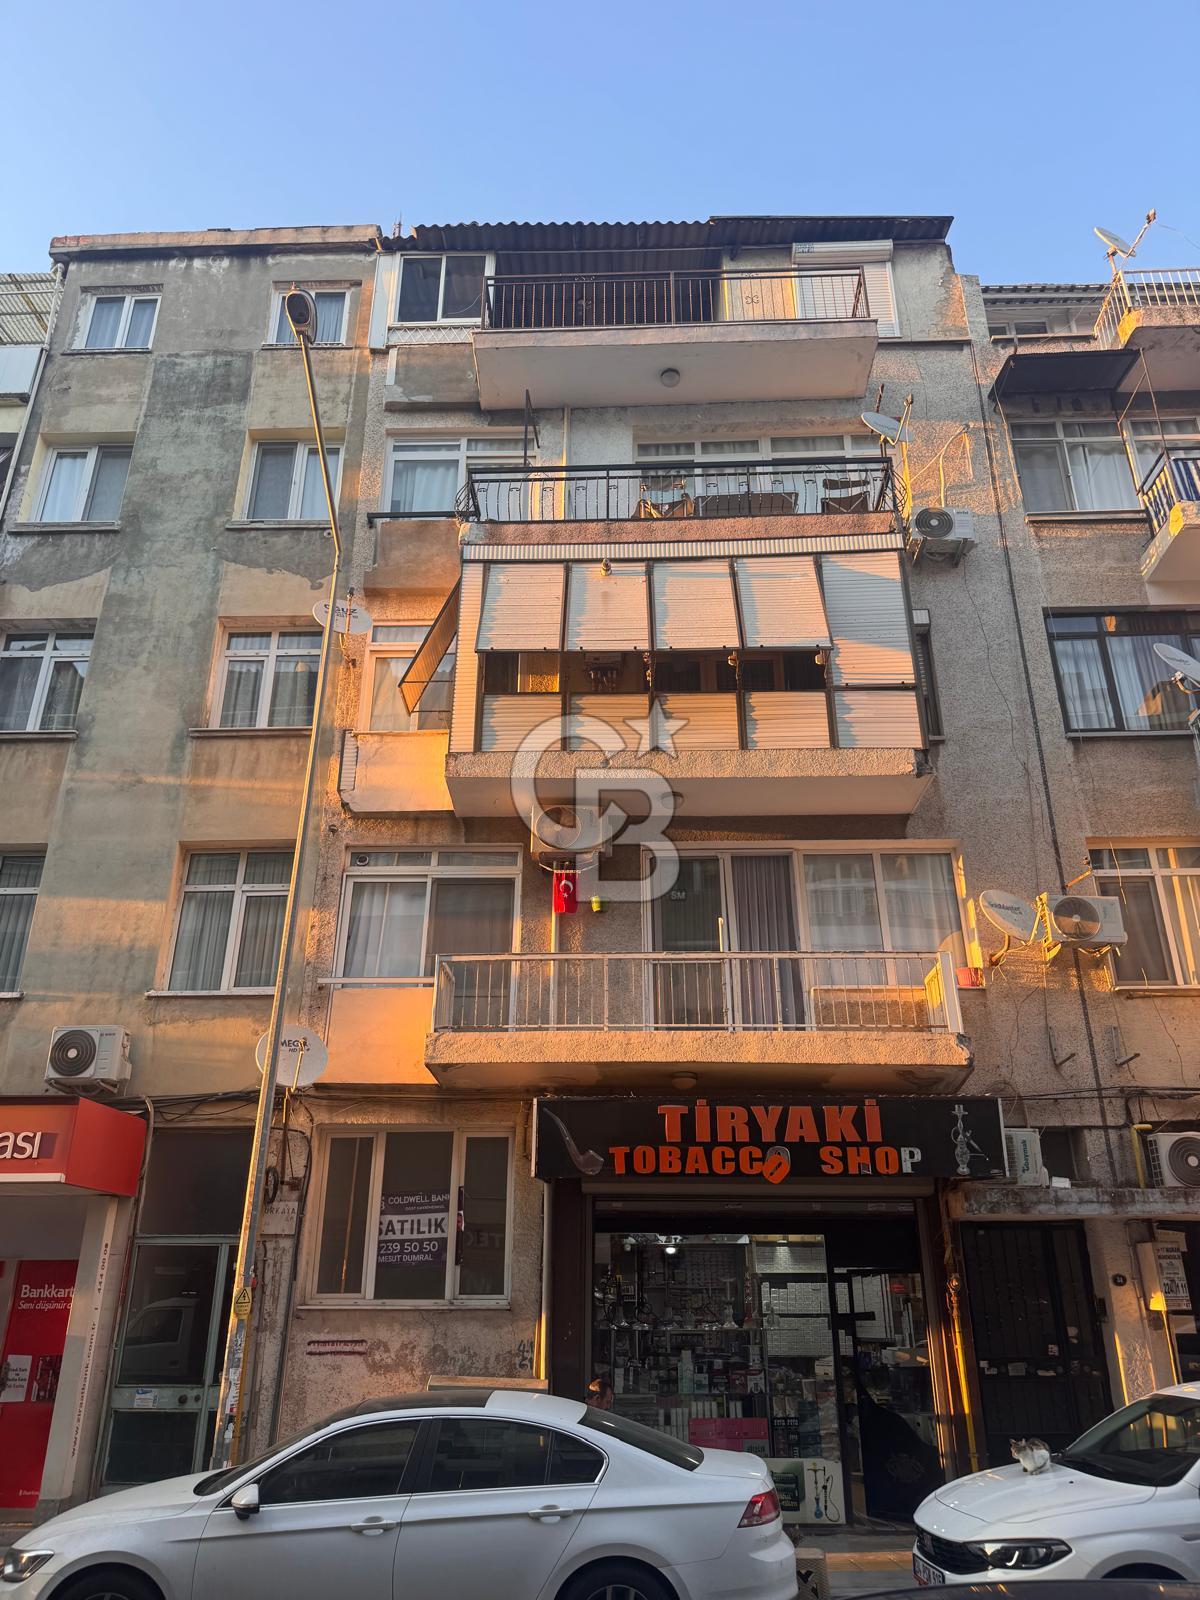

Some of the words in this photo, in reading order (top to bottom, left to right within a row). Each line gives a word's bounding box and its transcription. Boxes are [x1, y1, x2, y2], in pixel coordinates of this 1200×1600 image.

[657, 1099, 883, 1143] TİRYAKİ
[820, 1146, 922, 1176] SHOP
[388, 1195, 430, 1205] COLDWELL
[431, 1193, 450, 1203] BAN
[379, 1242, 401, 1254] 239
[404, 1242, 420, 1253] 50
[422, 1241, 439, 1252] 50
[402, 1254, 433, 1262] DUMRAL
[20, 1284, 75, 1298] Bankkart
